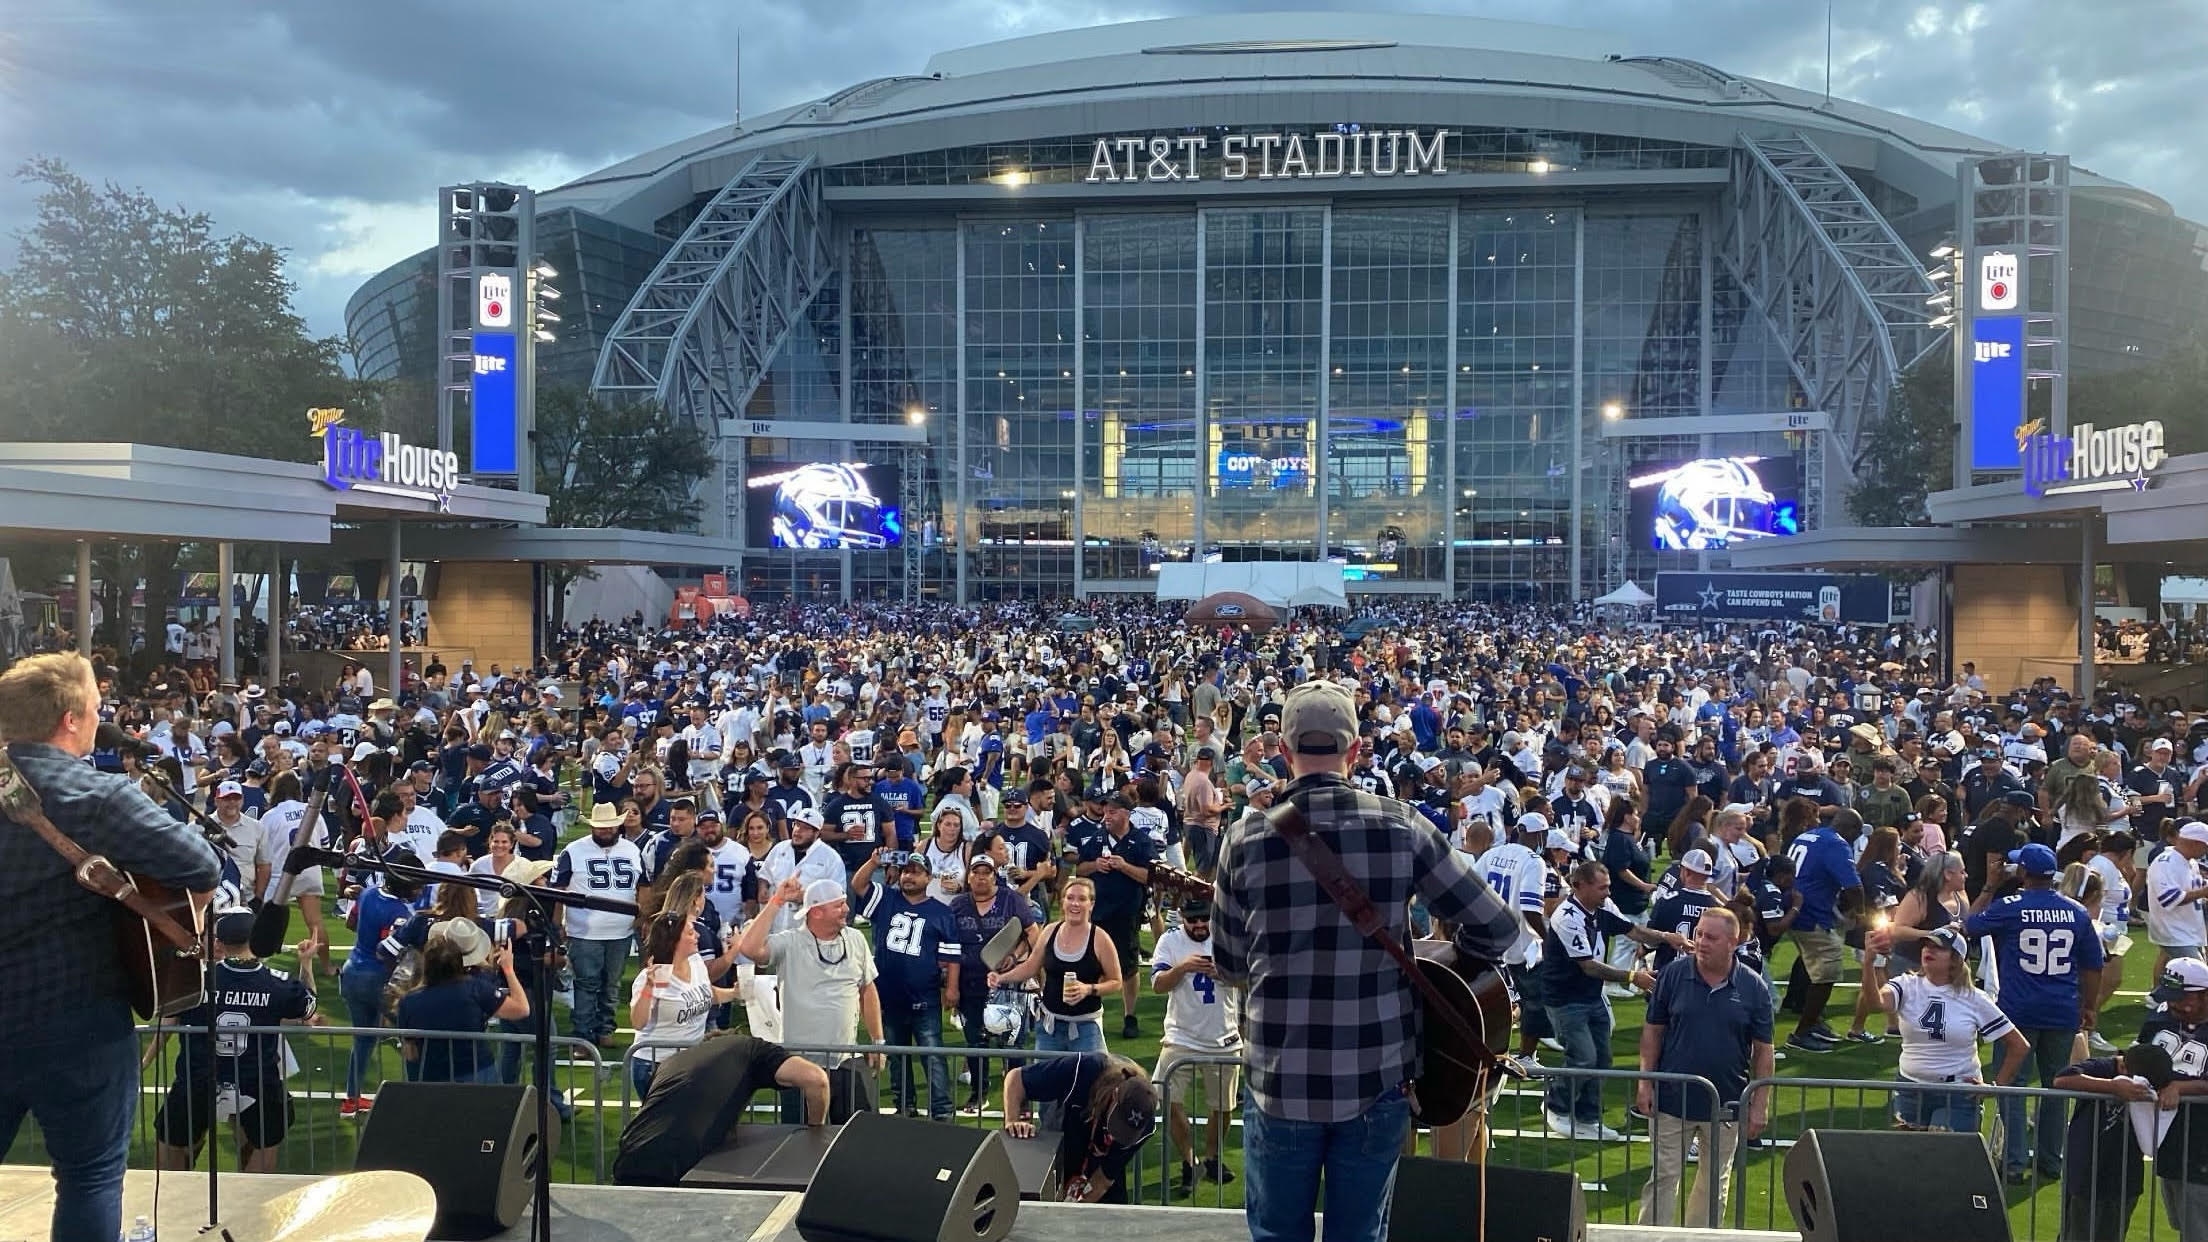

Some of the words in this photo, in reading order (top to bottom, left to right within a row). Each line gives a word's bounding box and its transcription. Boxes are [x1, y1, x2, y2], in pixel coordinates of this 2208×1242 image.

[1085, 135, 1208, 184] AT&T
[1220, 128, 1450, 181] STADIUM
[1986, 265, 2014, 281] Lite
[484, 286, 508, 300] Lite
[1974, 340, 2011, 362] Lite
[474, 354, 506, 375] Lite
[306, 407, 345, 432] Miller
[752, 421, 771, 434] Lite
[1788, 415, 1809, 428] Lite
[1727, 589, 1748, 598] TASTE
[1749, 590, 1784, 598] COWBOYS
[1785, 591, 1813, 599] NATION
[1727, 598, 1741, 606] CAN
[1771, 599, 1785, 607] ON.
[853, 747, 872, 761] 21
[841, 811, 876, 842] 21
[586, 858, 636, 891] 55
[1683, 903, 1709, 917] AUST
[2021, 909, 2075, 923] STRAHAN
[886, 912, 926, 957] 21
[1572, 935, 1584, 951] 4
[2018, 928, 2075, 976] 92
[1192, 972, 1215, 1004] 4
[225, 991, 271, 1008] GALVAN
[1919, 1000, 1946, 1042] 4
